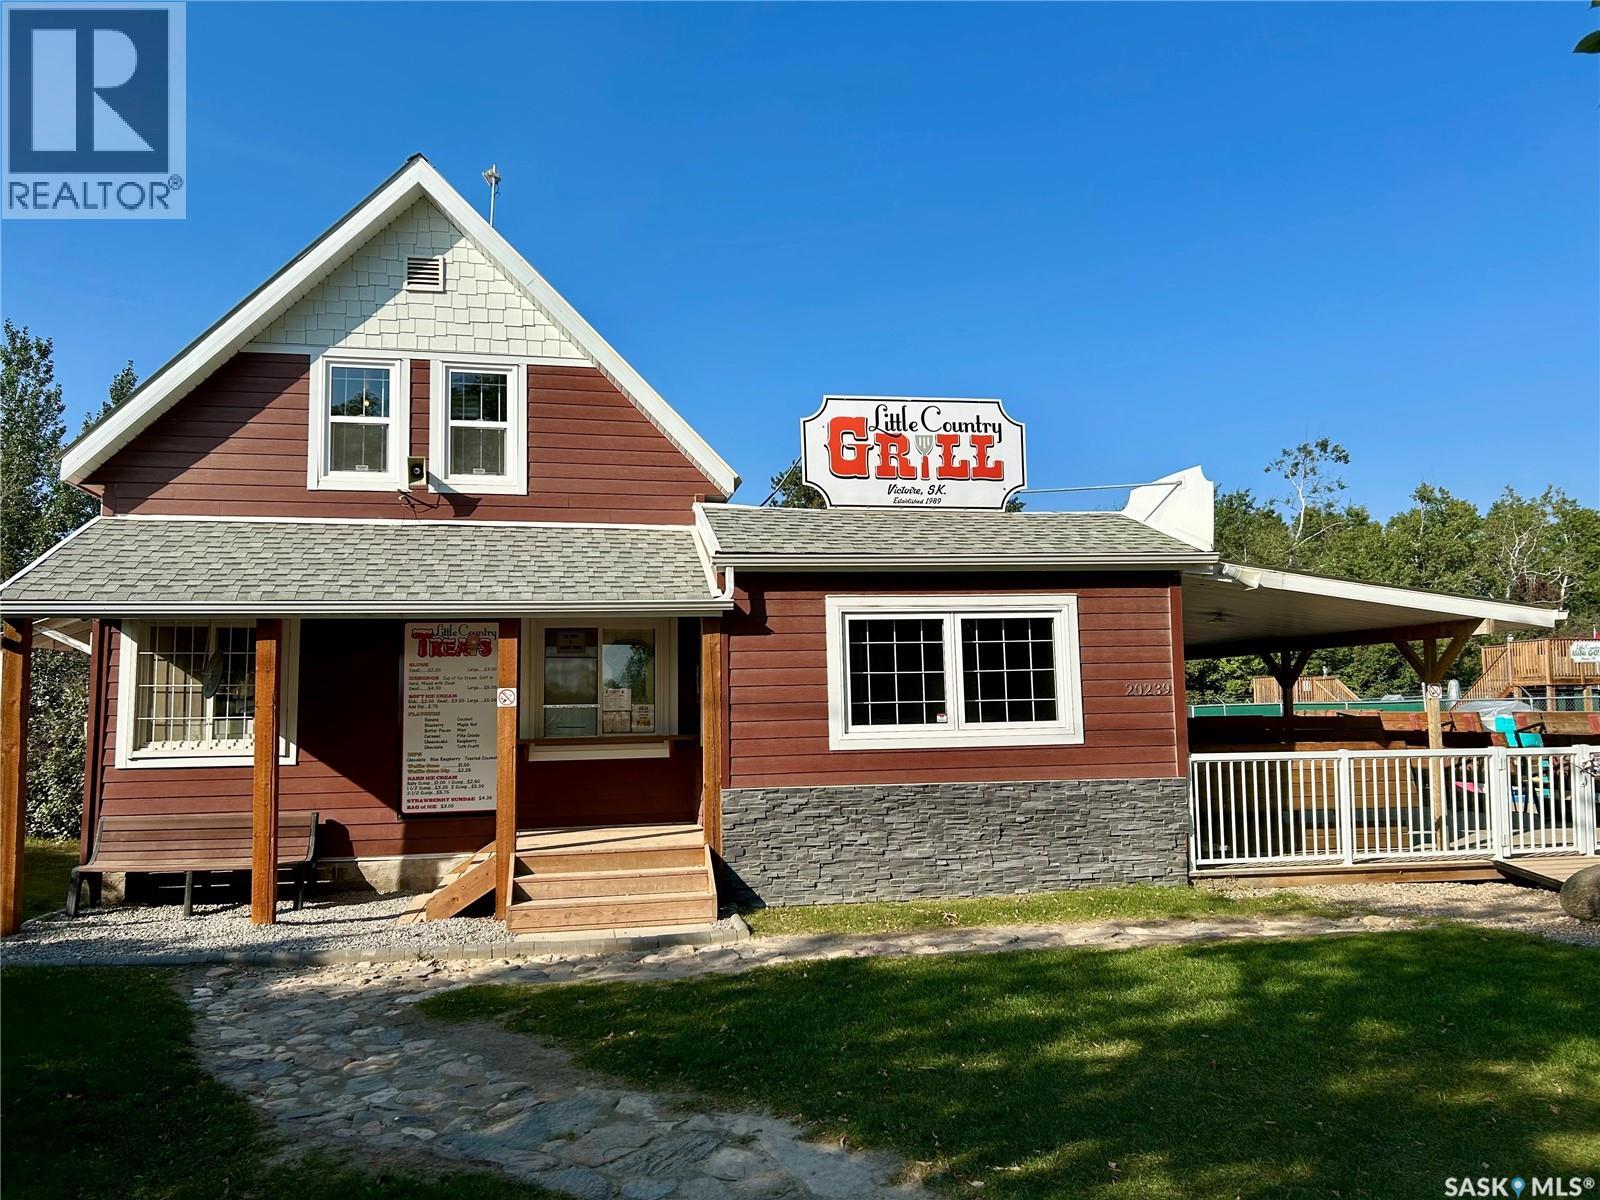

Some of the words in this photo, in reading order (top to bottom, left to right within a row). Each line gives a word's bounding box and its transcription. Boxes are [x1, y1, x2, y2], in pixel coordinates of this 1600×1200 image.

[868, 404, 918, 437] Little
[921, 405, 1002, 443] Country
[887, 484, 924, 495] Victoire,
[433, 624, 458, 637] Little
[1125, 683, 1171, 696] 20239
